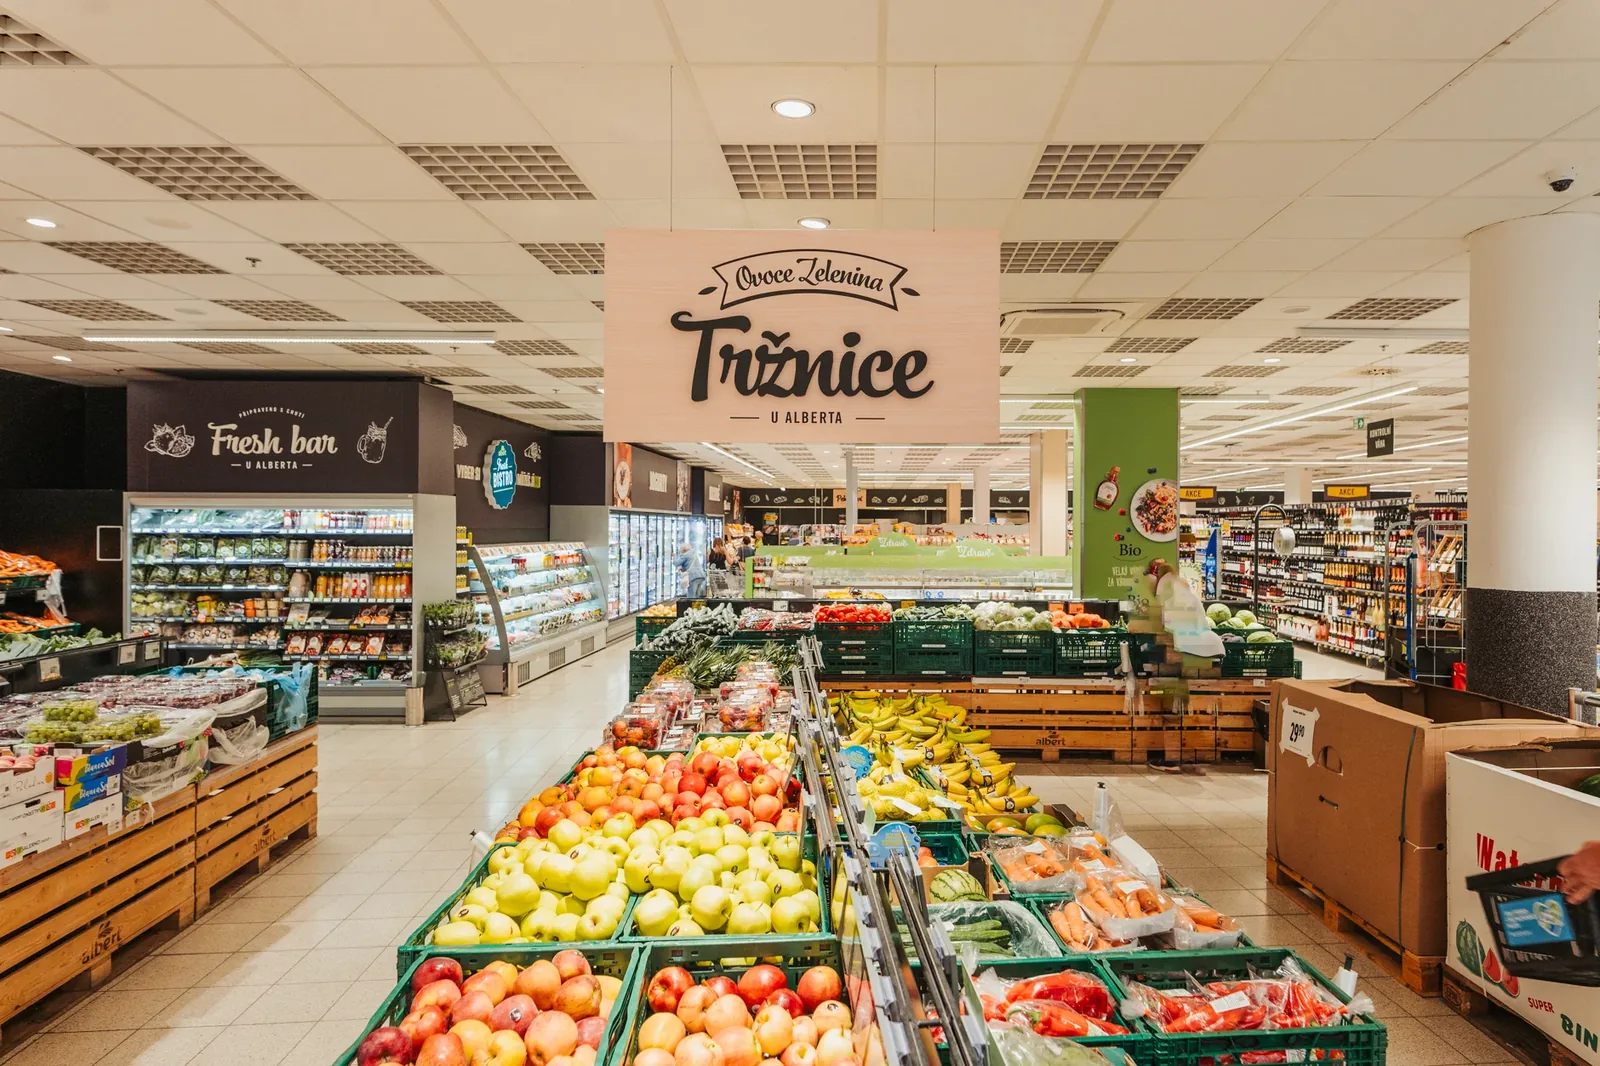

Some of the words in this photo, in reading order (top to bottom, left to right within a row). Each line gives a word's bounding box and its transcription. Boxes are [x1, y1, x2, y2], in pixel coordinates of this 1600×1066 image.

[735, 264, 795, 292] Ovoce
[796, 257, 884, 292] Zelenina
[670, 310, 935, 403] Tržnice
[771, 411, 779, 424] U
[785, 411, 843, 424] ALBERTA
[207, 422, 284, 456] Fresh
[290, 424, 338, 454] bar
[245, 461, 252, 470] U
[256, 461, 298, 470] ALBERTA
[492, 469, 514, 489] BISTRO
[1185, 489, 1202, 498] AKCE
[1339, 488, 1356, 496] AKCE
[1119, 543, 1142, 556] Bio
[1035, 737, 1066, 746] albert
[81, 929, 123, 965] albert
[1527, 997, 1555, 1014] SUPER
[1560, 1013, 1599, 1054] BIN
